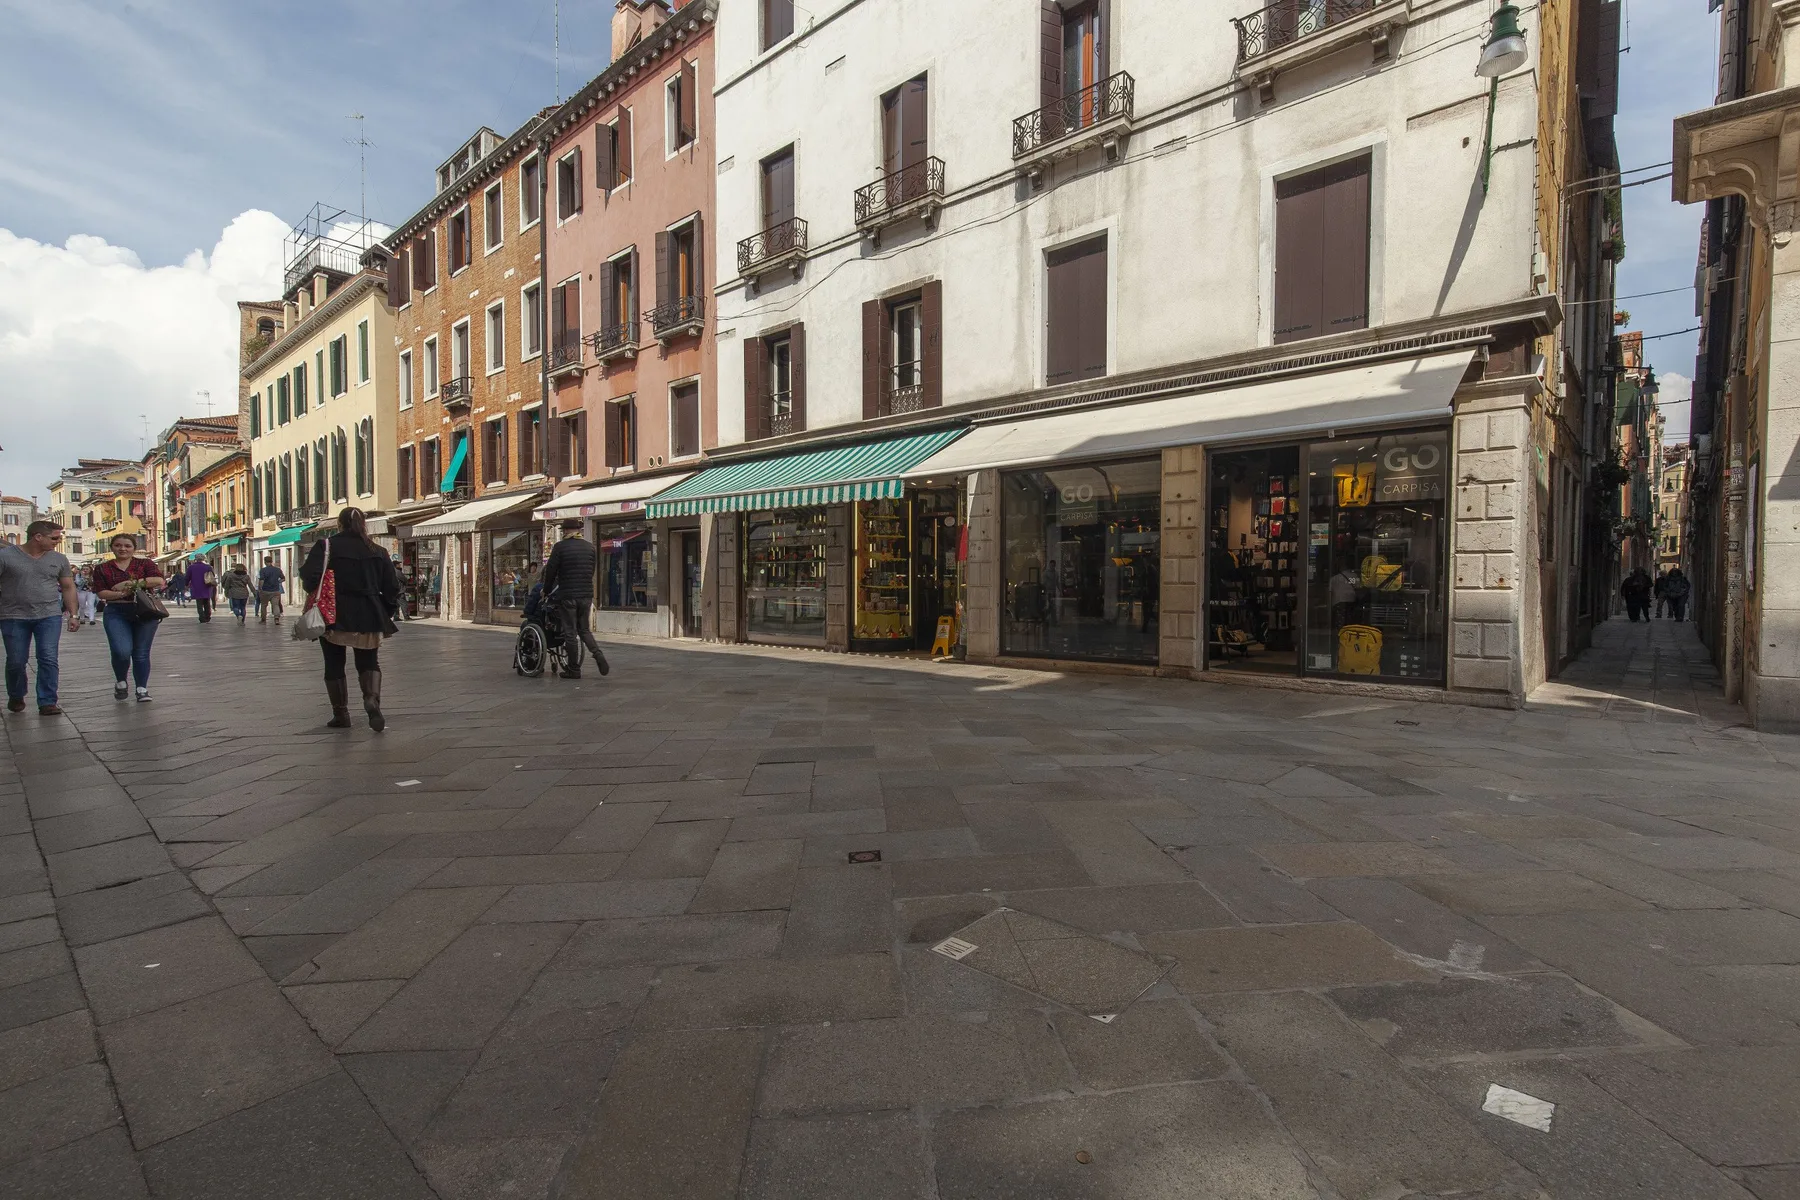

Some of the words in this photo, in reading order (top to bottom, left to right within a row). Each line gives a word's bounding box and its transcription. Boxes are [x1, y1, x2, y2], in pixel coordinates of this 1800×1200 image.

[1384, 444, 1440, 472] GO
[1061, 484, 1093, 504] GO
[1383, 482, 1439, 495] CARPISA
[1061, 511, 1093, 521] CARPISA
